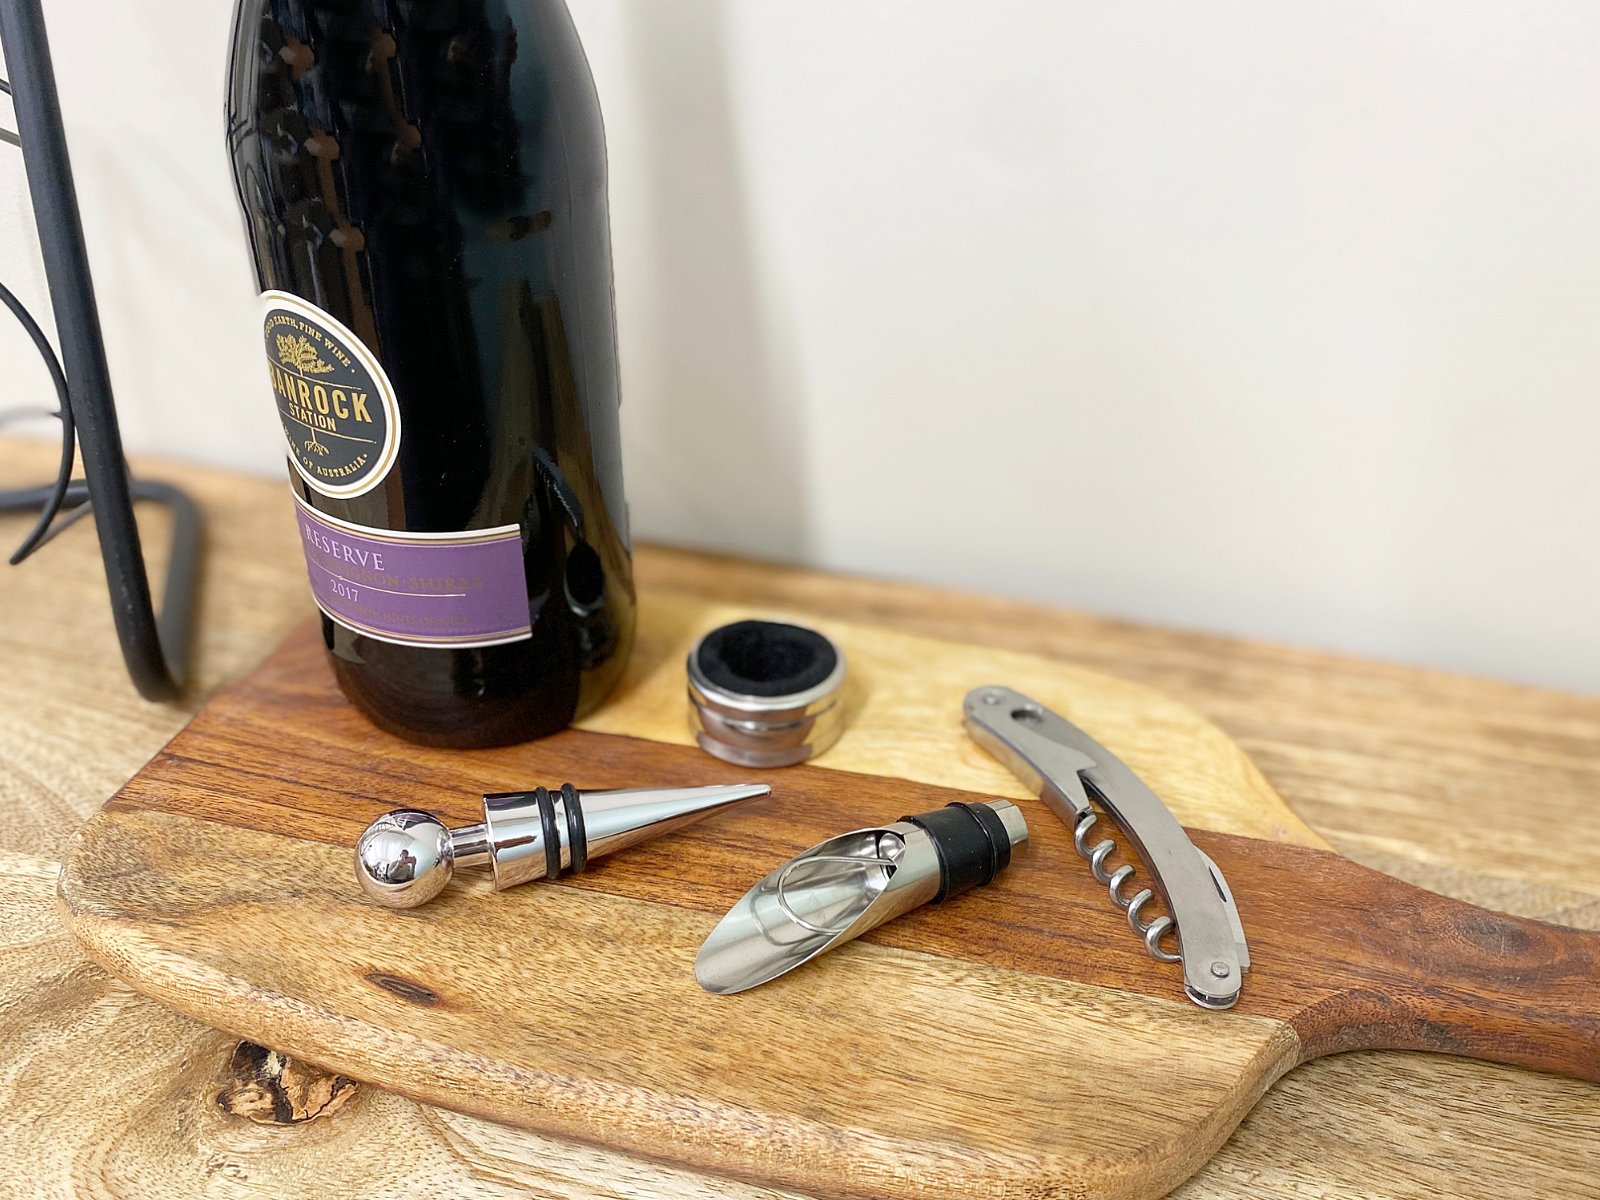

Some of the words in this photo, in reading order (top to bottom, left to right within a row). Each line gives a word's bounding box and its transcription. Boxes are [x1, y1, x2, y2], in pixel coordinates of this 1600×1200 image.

[299, 322, 322, 341] FINE
[324, 337, 351, 367] WINE
[288, 402, 337, 432] STATION
[302, 456, 314, 469] OF
[304, 522, 385, 572] RESERVE
[331, 579, 359, 602] 2017
